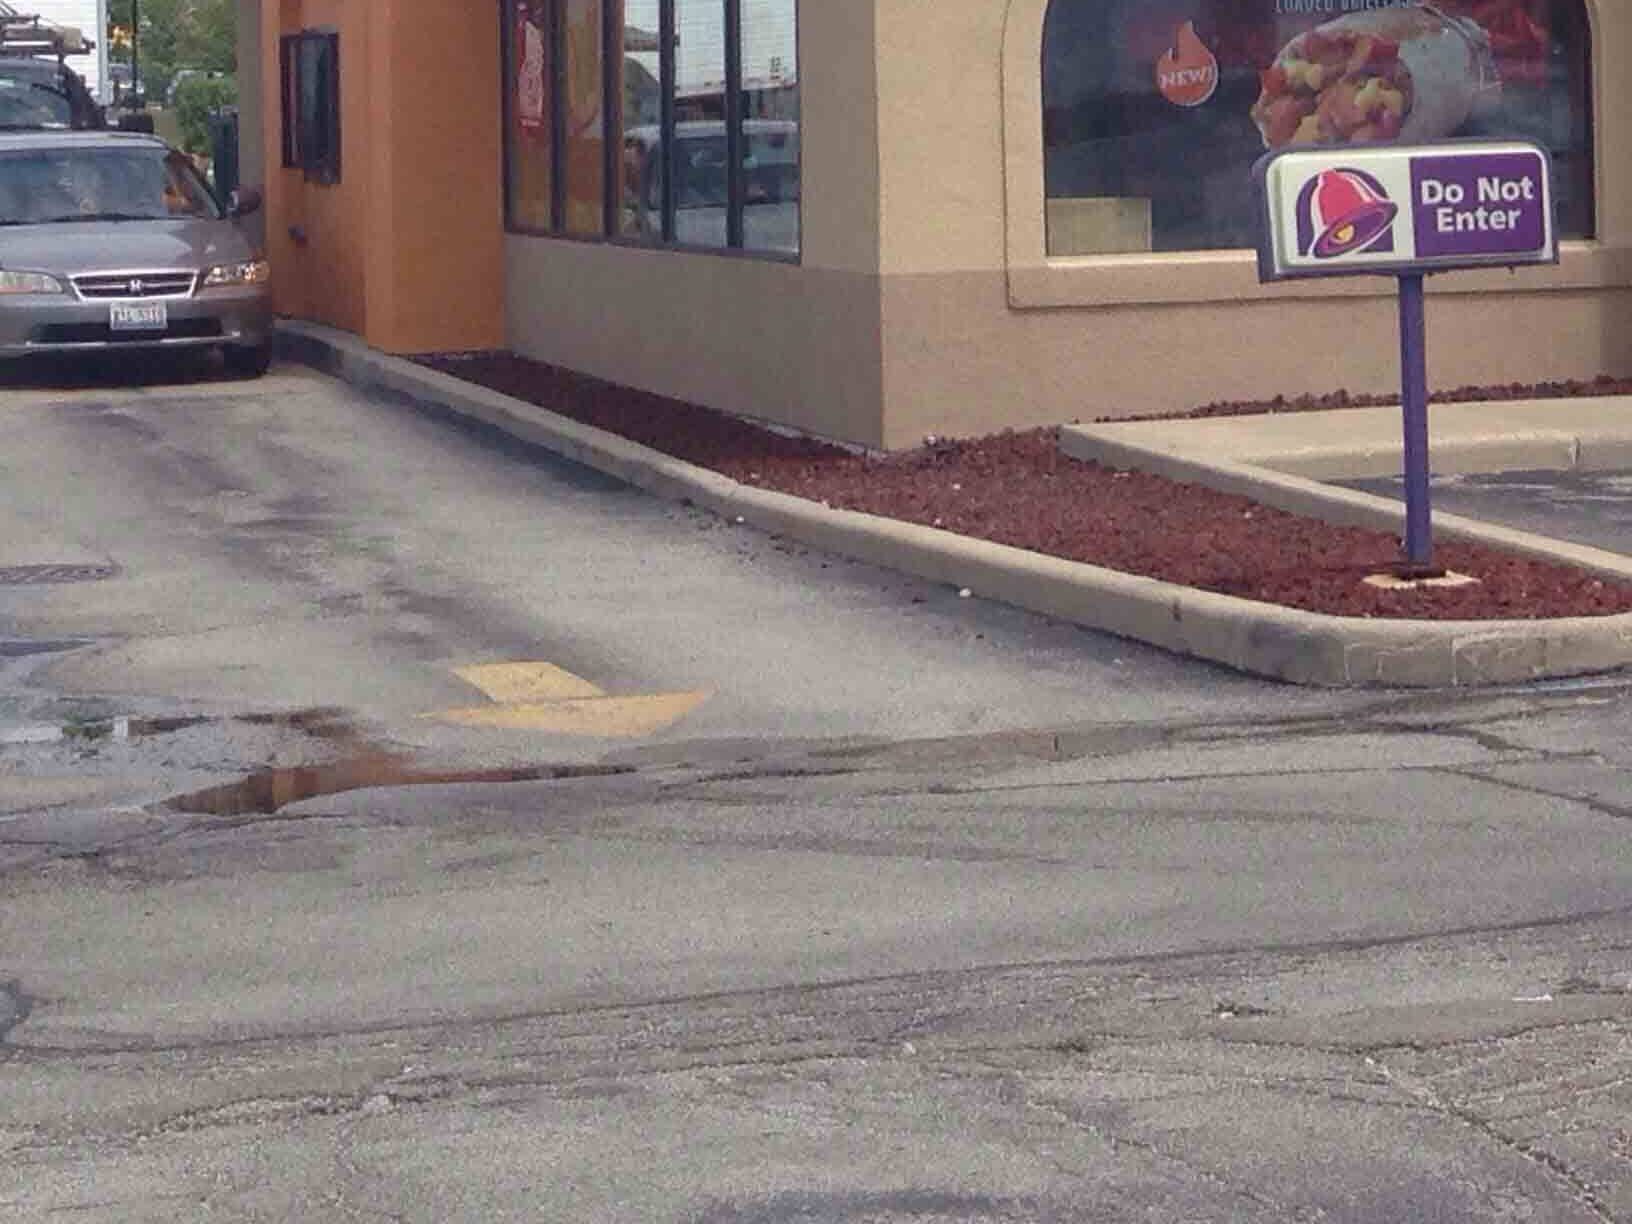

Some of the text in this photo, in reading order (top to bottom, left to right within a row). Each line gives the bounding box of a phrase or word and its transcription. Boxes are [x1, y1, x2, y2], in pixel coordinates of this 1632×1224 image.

[1421, 176, 1535, 205] Do Not
[1436, 206, 1522, 233] Enter
